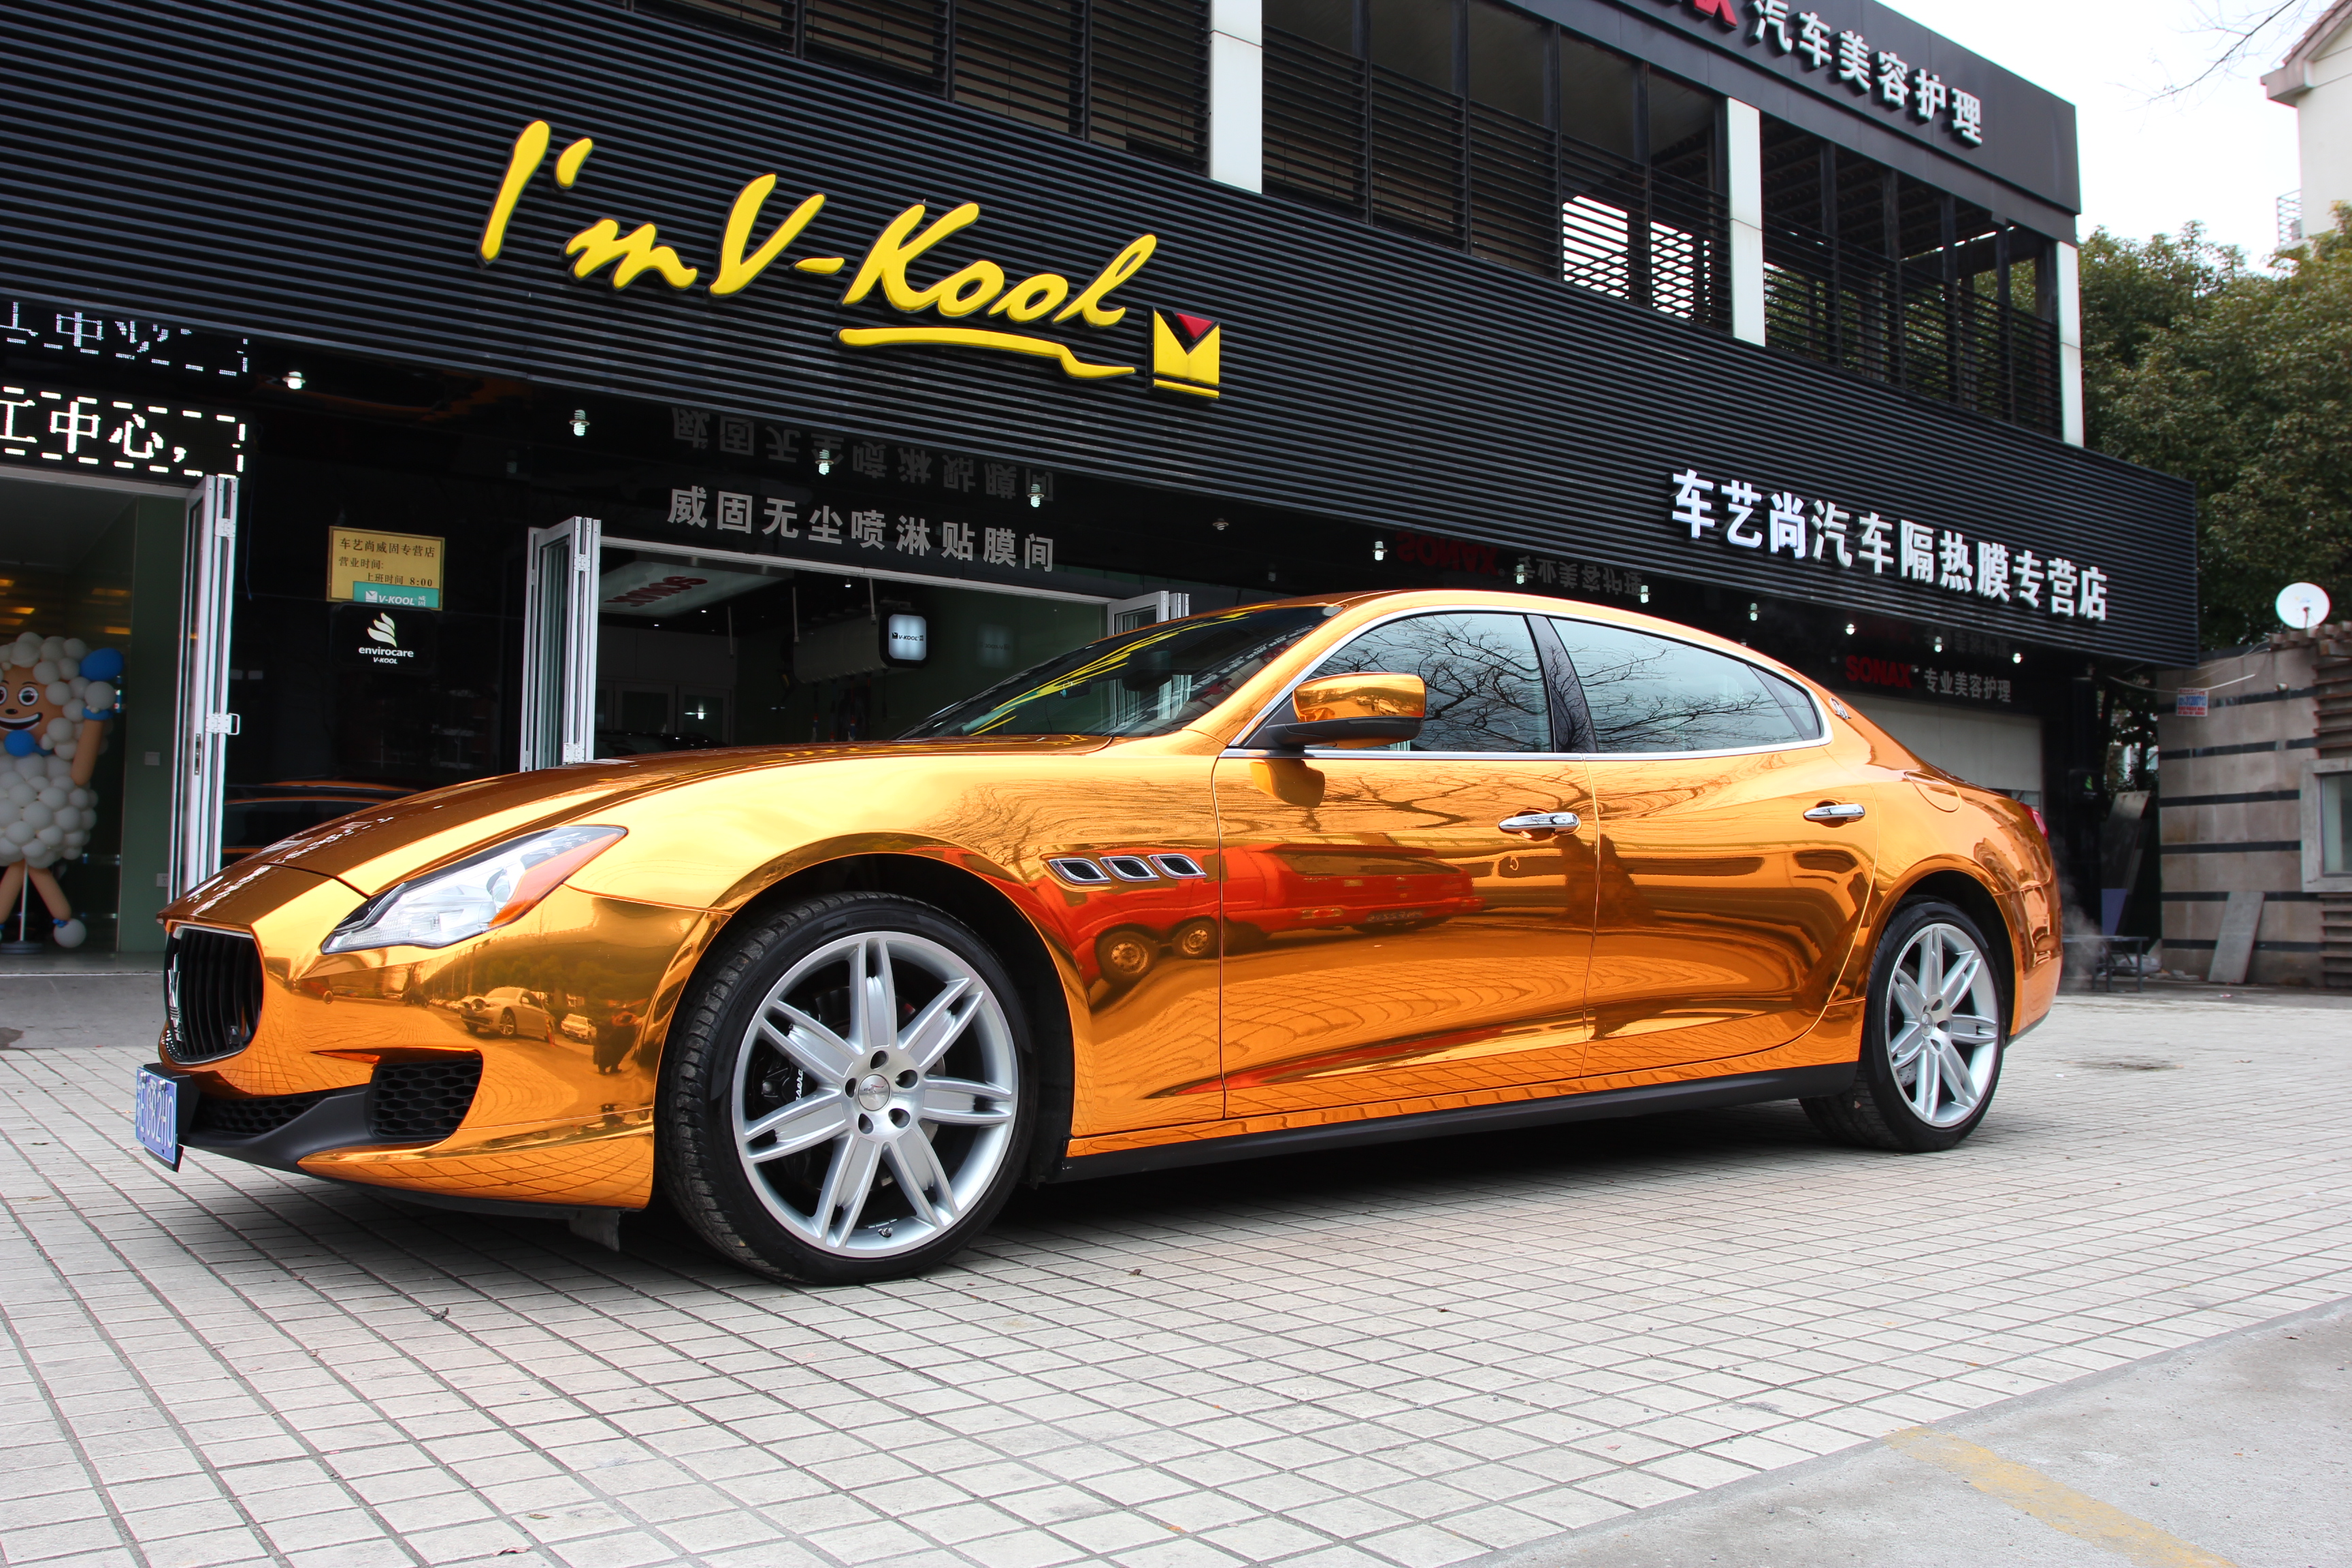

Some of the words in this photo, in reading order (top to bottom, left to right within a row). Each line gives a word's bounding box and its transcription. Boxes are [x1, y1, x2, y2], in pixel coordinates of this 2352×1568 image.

[1753, 0, 1982, 147] 汽车美容护理
[481, 120, 699, 288] I'm
[709, 173, 1157, 327] V-Kool
[668, 485, 1054, 572] 威固无尘喷淋贴膜间
[1671, 468, 2108, 621] 车艺尚汽车隔热膜专营店
[339, 537, 436, 558] 车艺尚威固专营店
[365, 572, 404, 585] 上班时间
[410, 577, 433, 587] 8:00
[379, 595, 414, 606] V-KOOL
[358, 646, 414, 658] envirocare
[1845, 655, 1913, 689] SONAX
[1923, 667, 2012, 703] 专业美容护理
